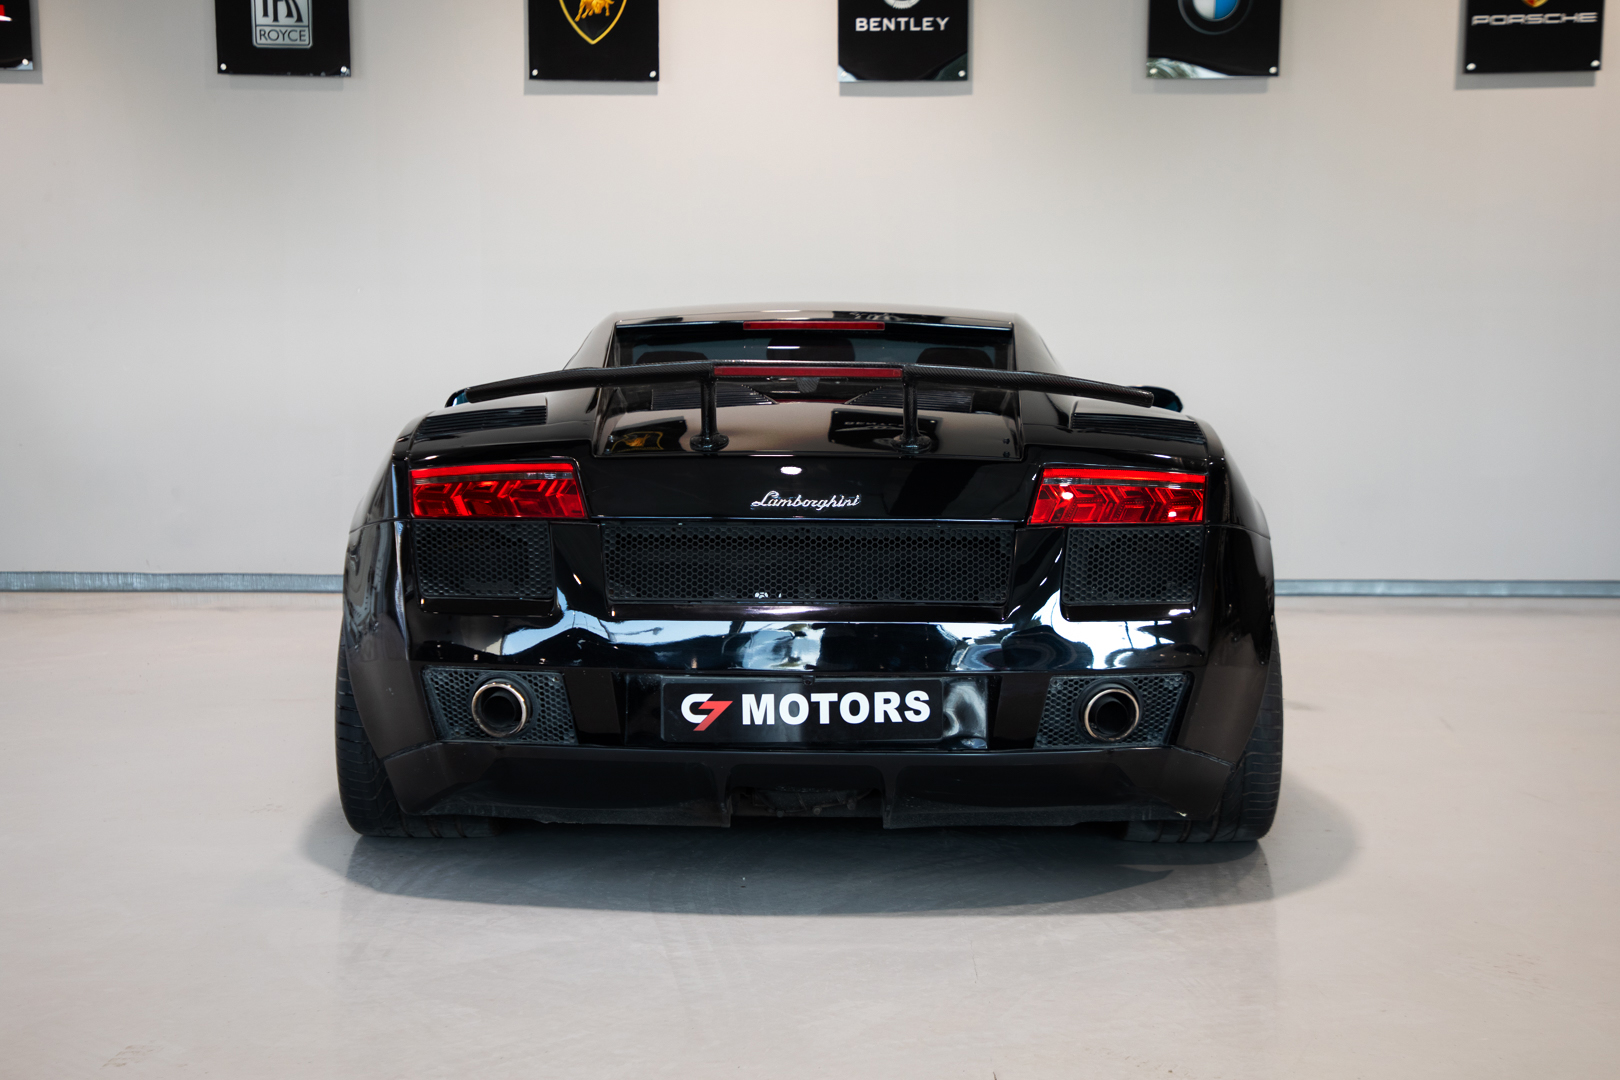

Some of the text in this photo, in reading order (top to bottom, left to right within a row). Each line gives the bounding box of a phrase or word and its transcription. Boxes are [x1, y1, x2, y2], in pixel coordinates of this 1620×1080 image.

[855, 17, 950, 32] BENTLEY
[1471, 12, 1598, 26] PORSCHE
[259, 29, 307, 42] ROYCE
[751, 490, 861, 511] Lamborghini
[742, 690, 931, 725] MOTORS
